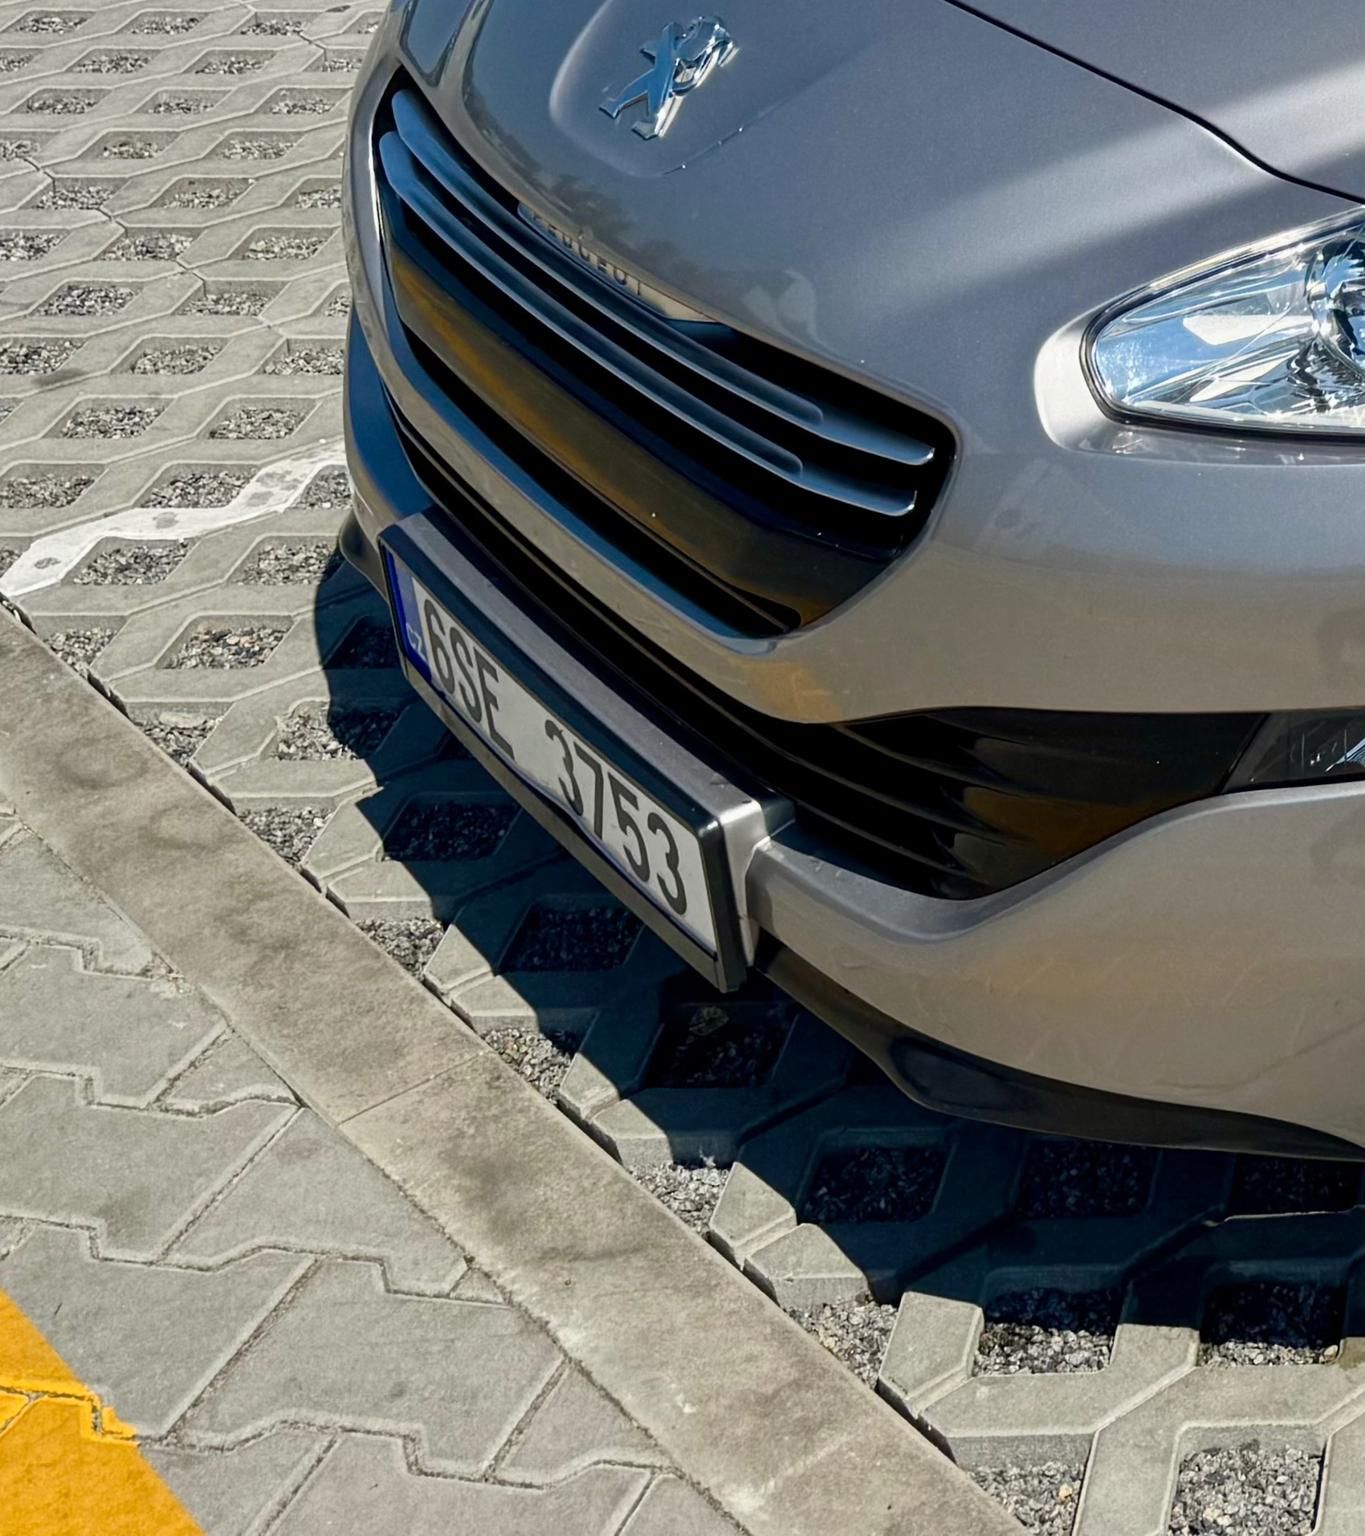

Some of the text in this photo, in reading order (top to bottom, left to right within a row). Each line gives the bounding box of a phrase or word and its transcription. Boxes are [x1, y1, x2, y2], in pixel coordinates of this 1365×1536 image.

[406, 622, 427, 663] CZ
[423, 598, 687, 916] 6SE 3753
